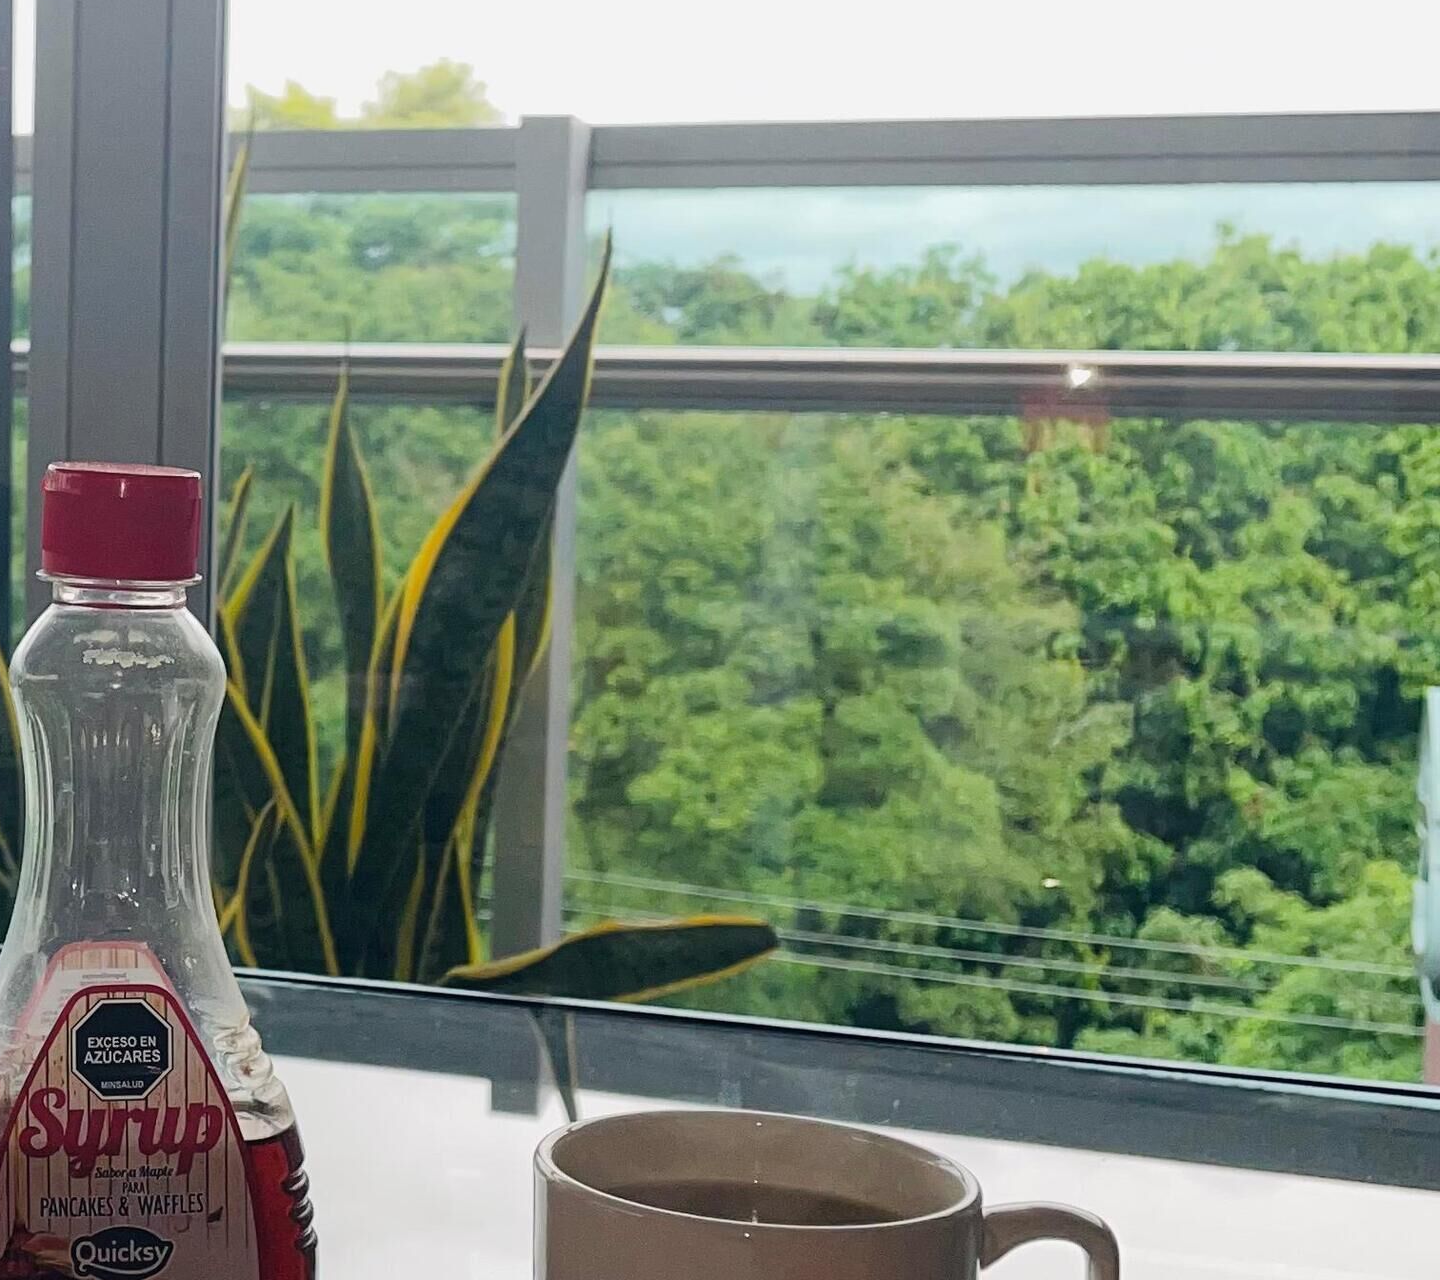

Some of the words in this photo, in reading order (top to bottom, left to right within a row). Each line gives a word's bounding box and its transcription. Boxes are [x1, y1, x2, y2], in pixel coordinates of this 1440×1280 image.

[87, 1036, 137, 1049] EXCESO
[140, 1036, 157, 1047] EN
[84, 1046, 161, 1064] AZÚCARES
[100, 1080, 144, 1090] MINSALUD
[19, 1087, 223, 1178] Syrup
[95, 1166, 127, 1178] Sabor
[128, 1169, 137, 1178] a
[139, 1166, 174, 1178] Maple
[122, 1181, 146, 1194] PARA
[40, 1196, 113, 1217] PANCAKES
[118, 1198, 129, 1216] &
[139, 1193, 204, 1215] WAFFLES
[75, 1239, 169, 1273] Quicksy
